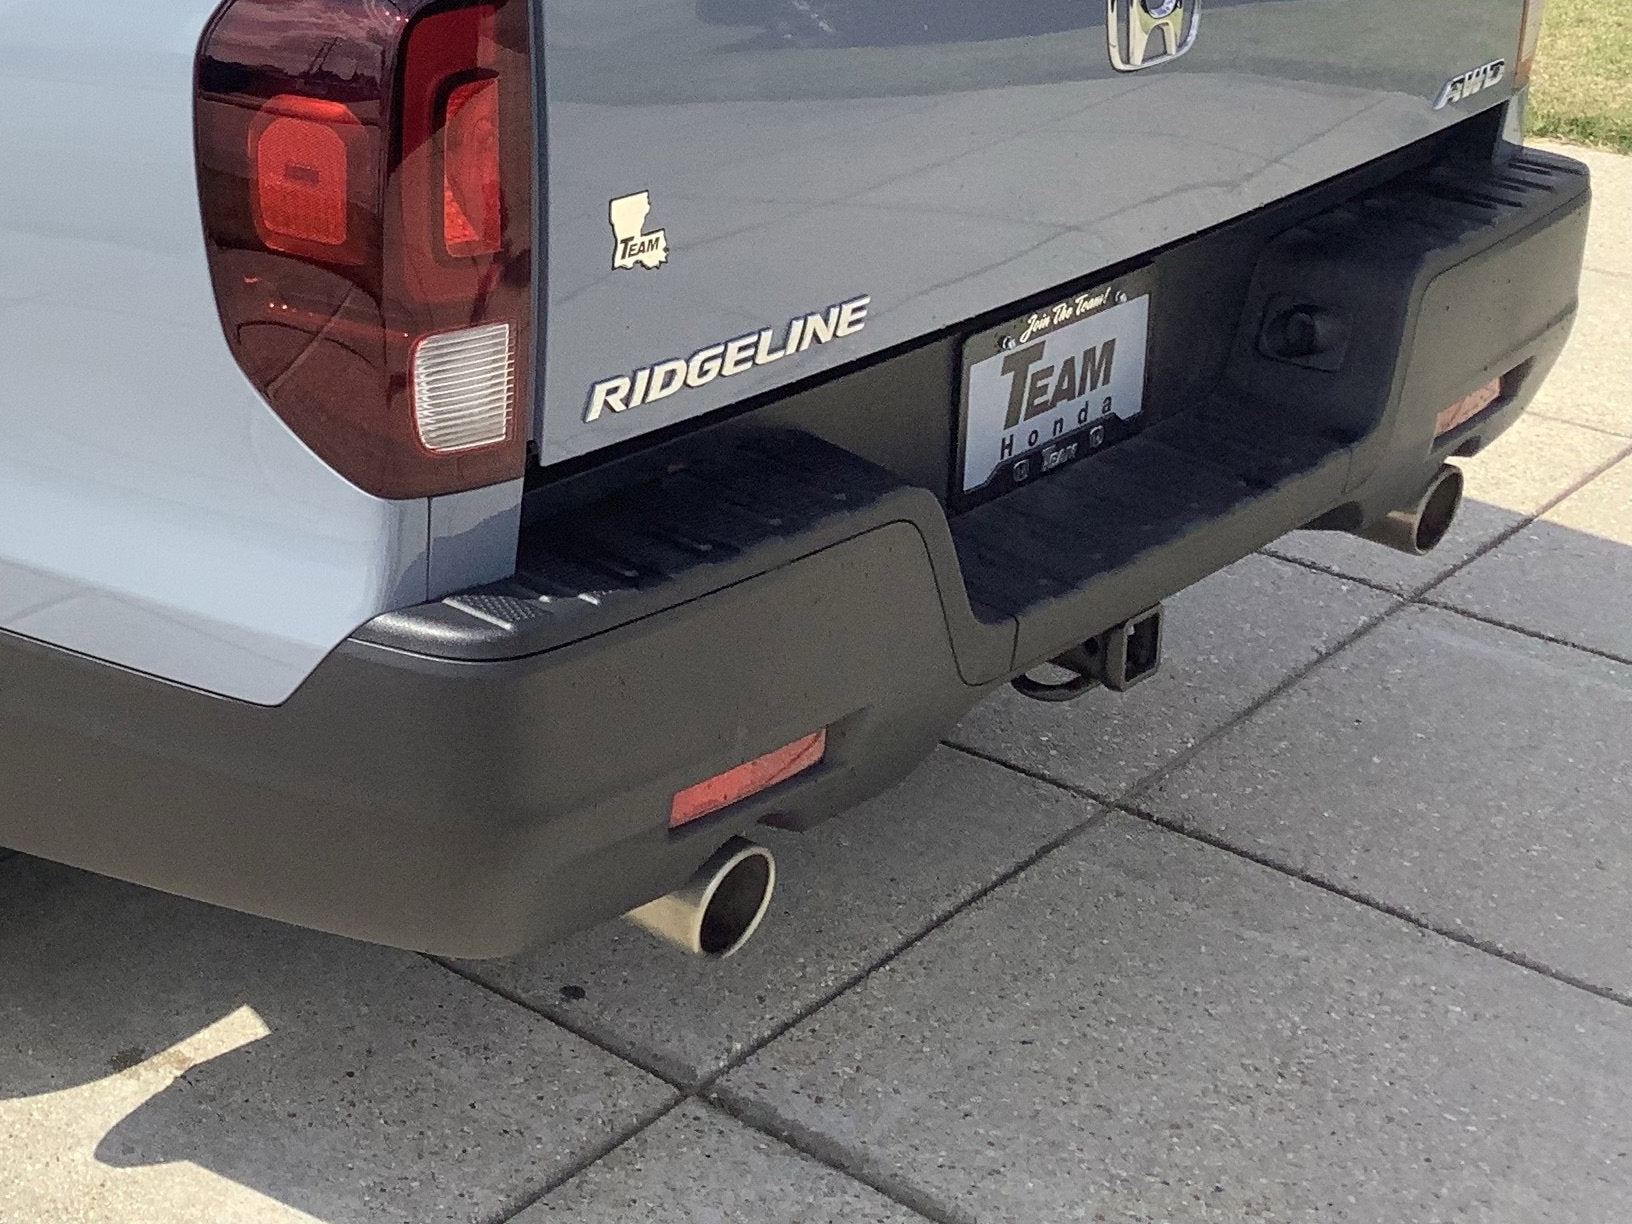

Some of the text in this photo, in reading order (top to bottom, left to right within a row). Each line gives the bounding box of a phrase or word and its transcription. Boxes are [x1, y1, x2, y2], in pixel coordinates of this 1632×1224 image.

[1433, 58, 1505, 110] AWD
[1020, 287, 1112, 343] Join The Team!
[582, 294, 871, 424] RIDGELINE
